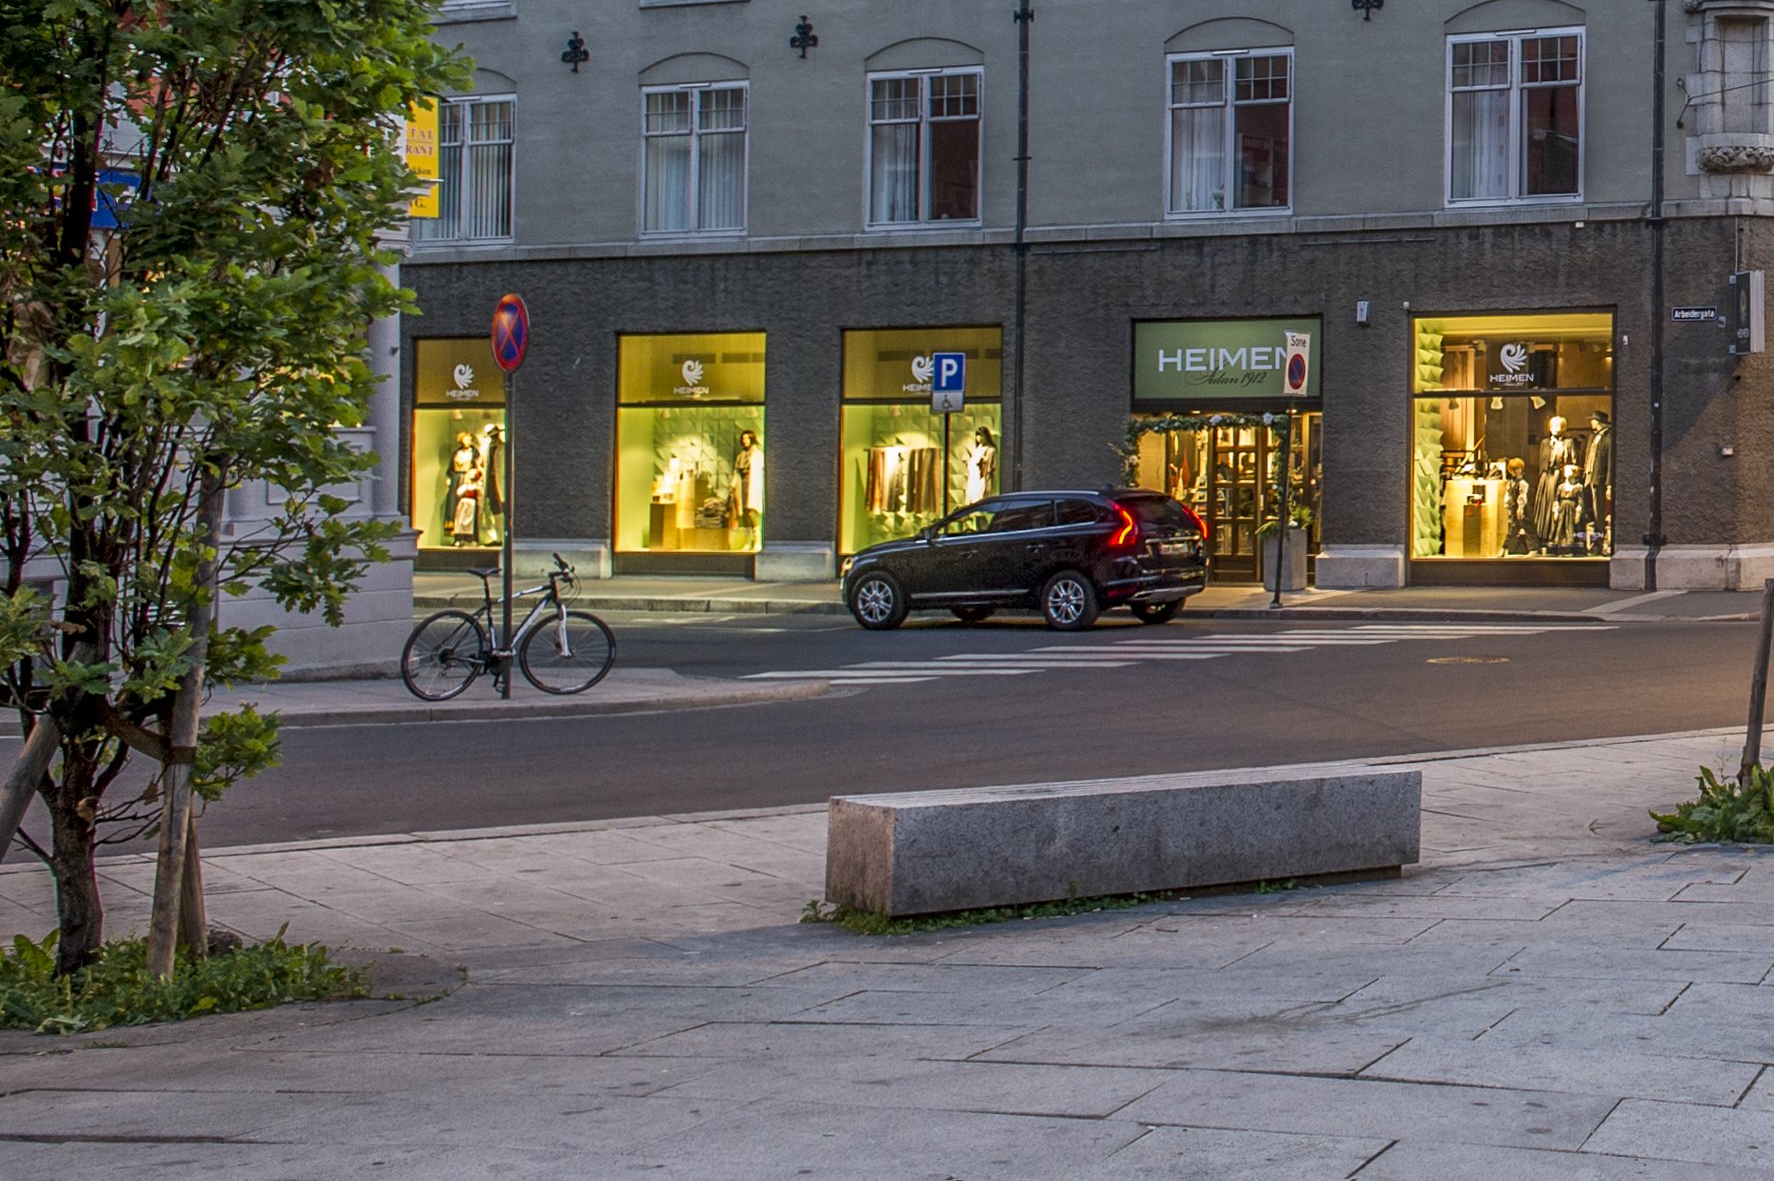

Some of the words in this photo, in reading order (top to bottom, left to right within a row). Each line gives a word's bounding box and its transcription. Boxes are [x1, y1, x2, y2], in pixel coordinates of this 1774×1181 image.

[1291, 335, 1307, 348] Sone
[942, 359, 958, 387] P
[1489, 373, 1534, 382] HEIMEN
[902, 384, 932, 392] HEIME
